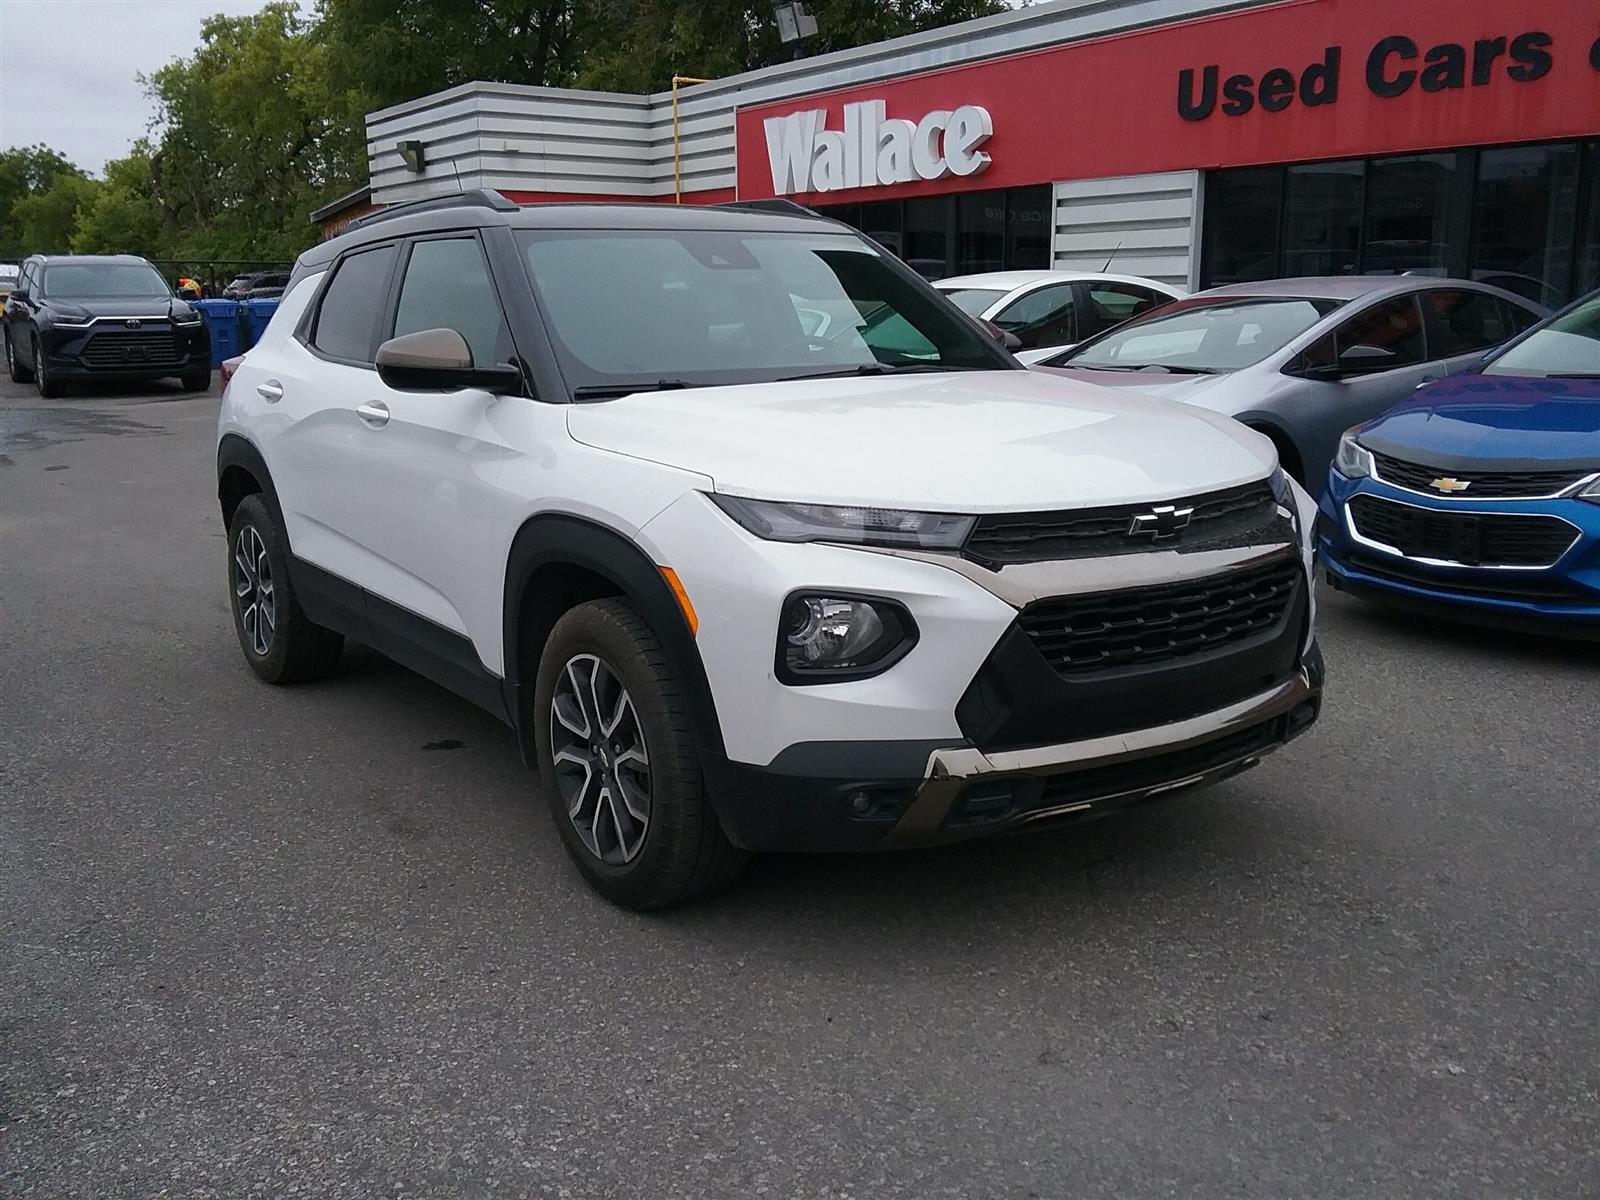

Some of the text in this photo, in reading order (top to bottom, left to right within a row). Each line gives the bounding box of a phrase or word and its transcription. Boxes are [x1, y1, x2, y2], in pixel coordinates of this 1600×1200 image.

[1177, 45, 1341, 122] Used
[1365, 31, 1553, 98] Cars
[763, 99, 993, 195] Wallace
